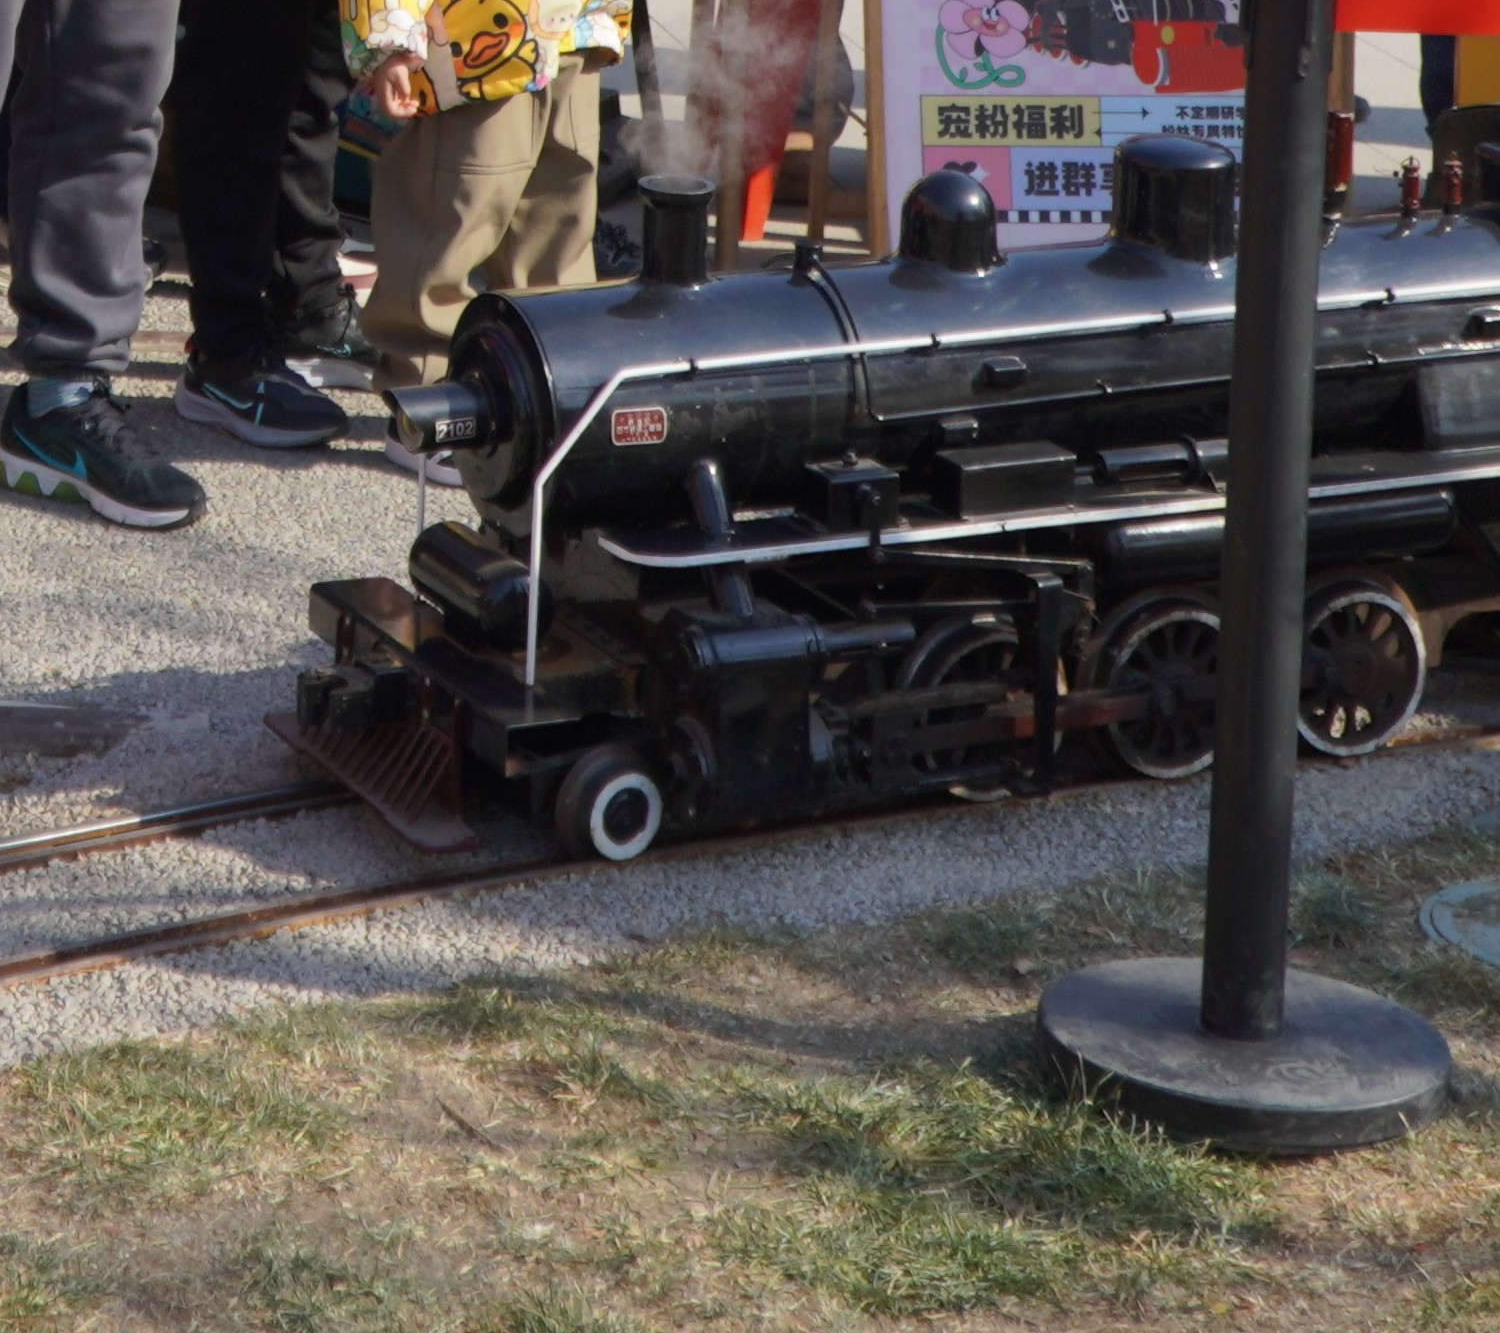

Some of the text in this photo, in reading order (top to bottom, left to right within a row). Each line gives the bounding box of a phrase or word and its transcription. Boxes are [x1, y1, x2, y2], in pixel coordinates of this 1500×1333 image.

[937, 104, 1085, 139] 宠粉福利
[438, 419, 474, 438] 2102
